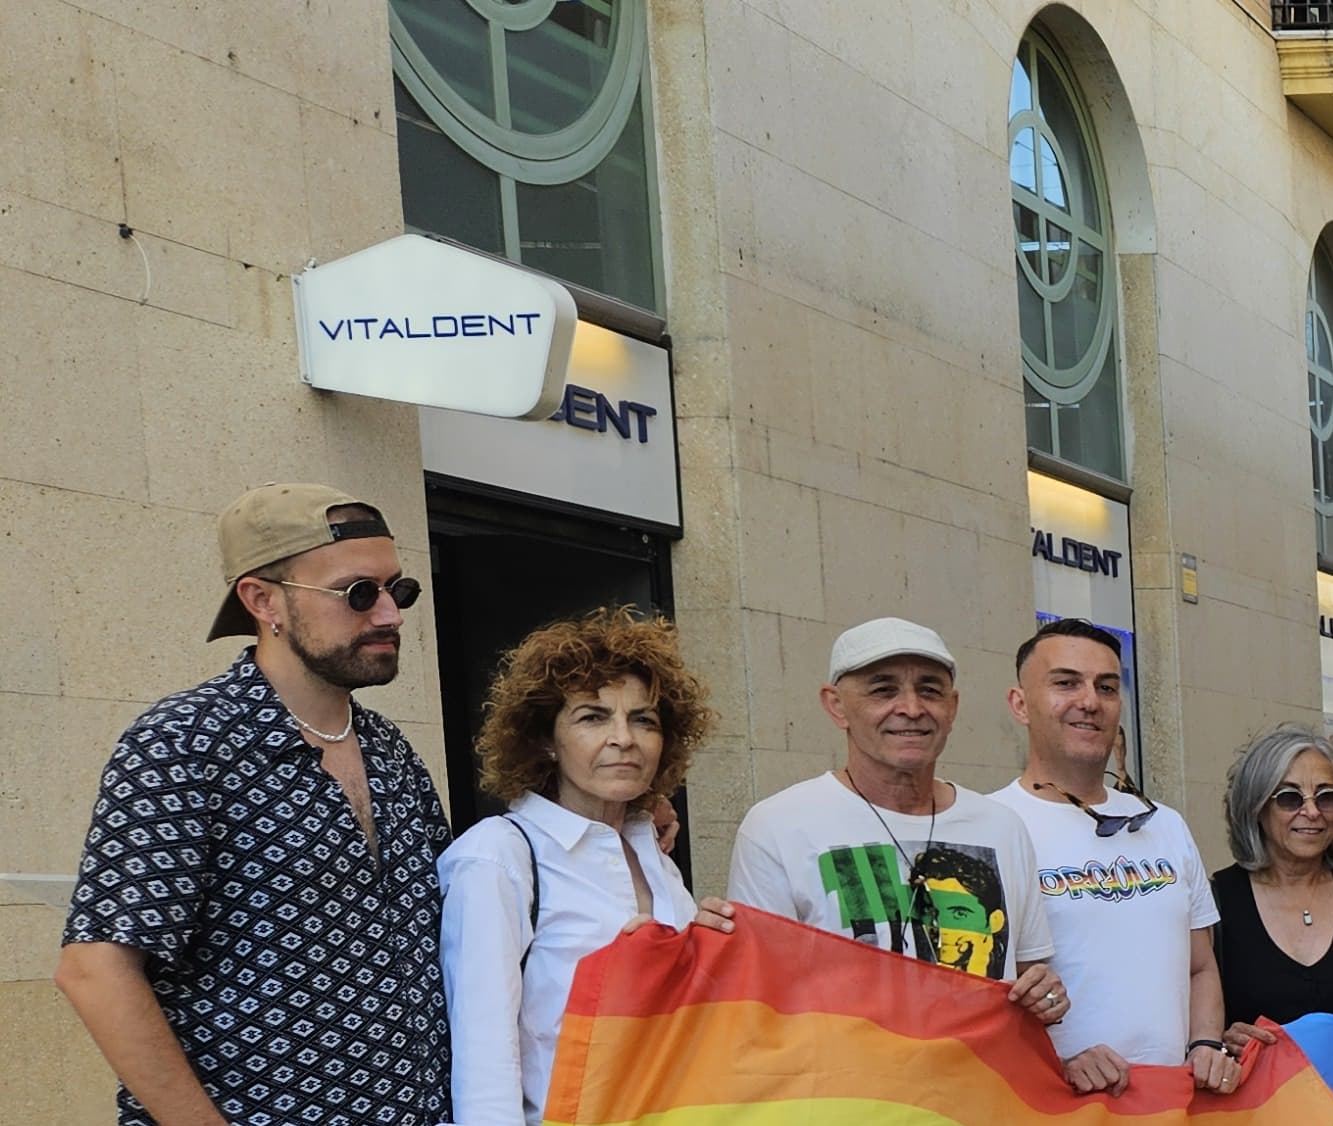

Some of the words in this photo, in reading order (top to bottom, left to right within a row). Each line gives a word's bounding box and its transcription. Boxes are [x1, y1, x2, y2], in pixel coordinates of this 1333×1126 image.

[318, 313, 542, 341] VITALDENT
[1030, 527, 1122, 578] ALDENT
[1038, 855, 1177, 903] ORGULLO
